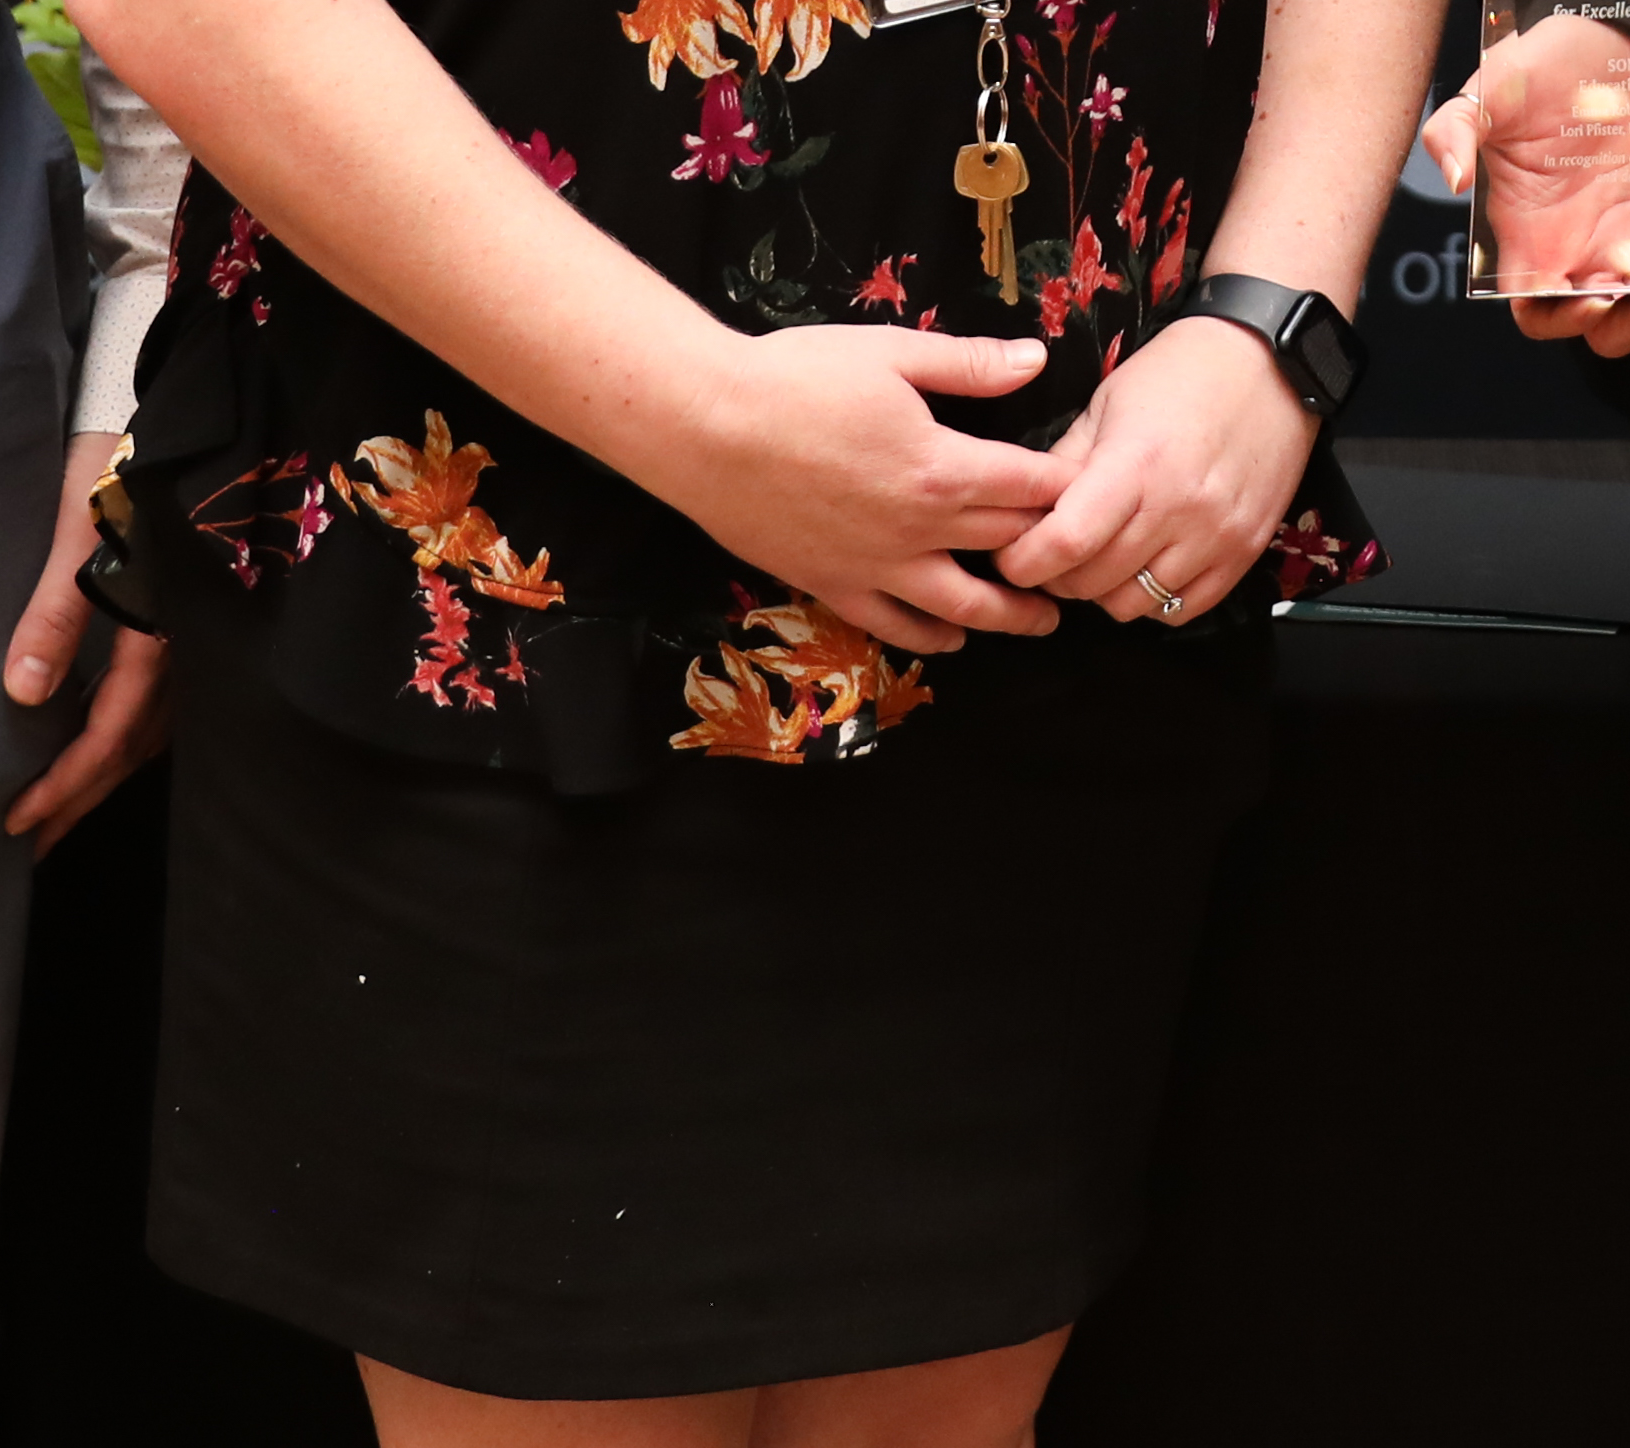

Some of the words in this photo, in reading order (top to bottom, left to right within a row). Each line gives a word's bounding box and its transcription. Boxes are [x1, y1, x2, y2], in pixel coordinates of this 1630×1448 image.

[1560, 124, 1584, 138] Lori
[1544, 154, 1556, 168] In
[1559, 150, 1626, 168] recognition
[1392, 231, 1467, 304] of
